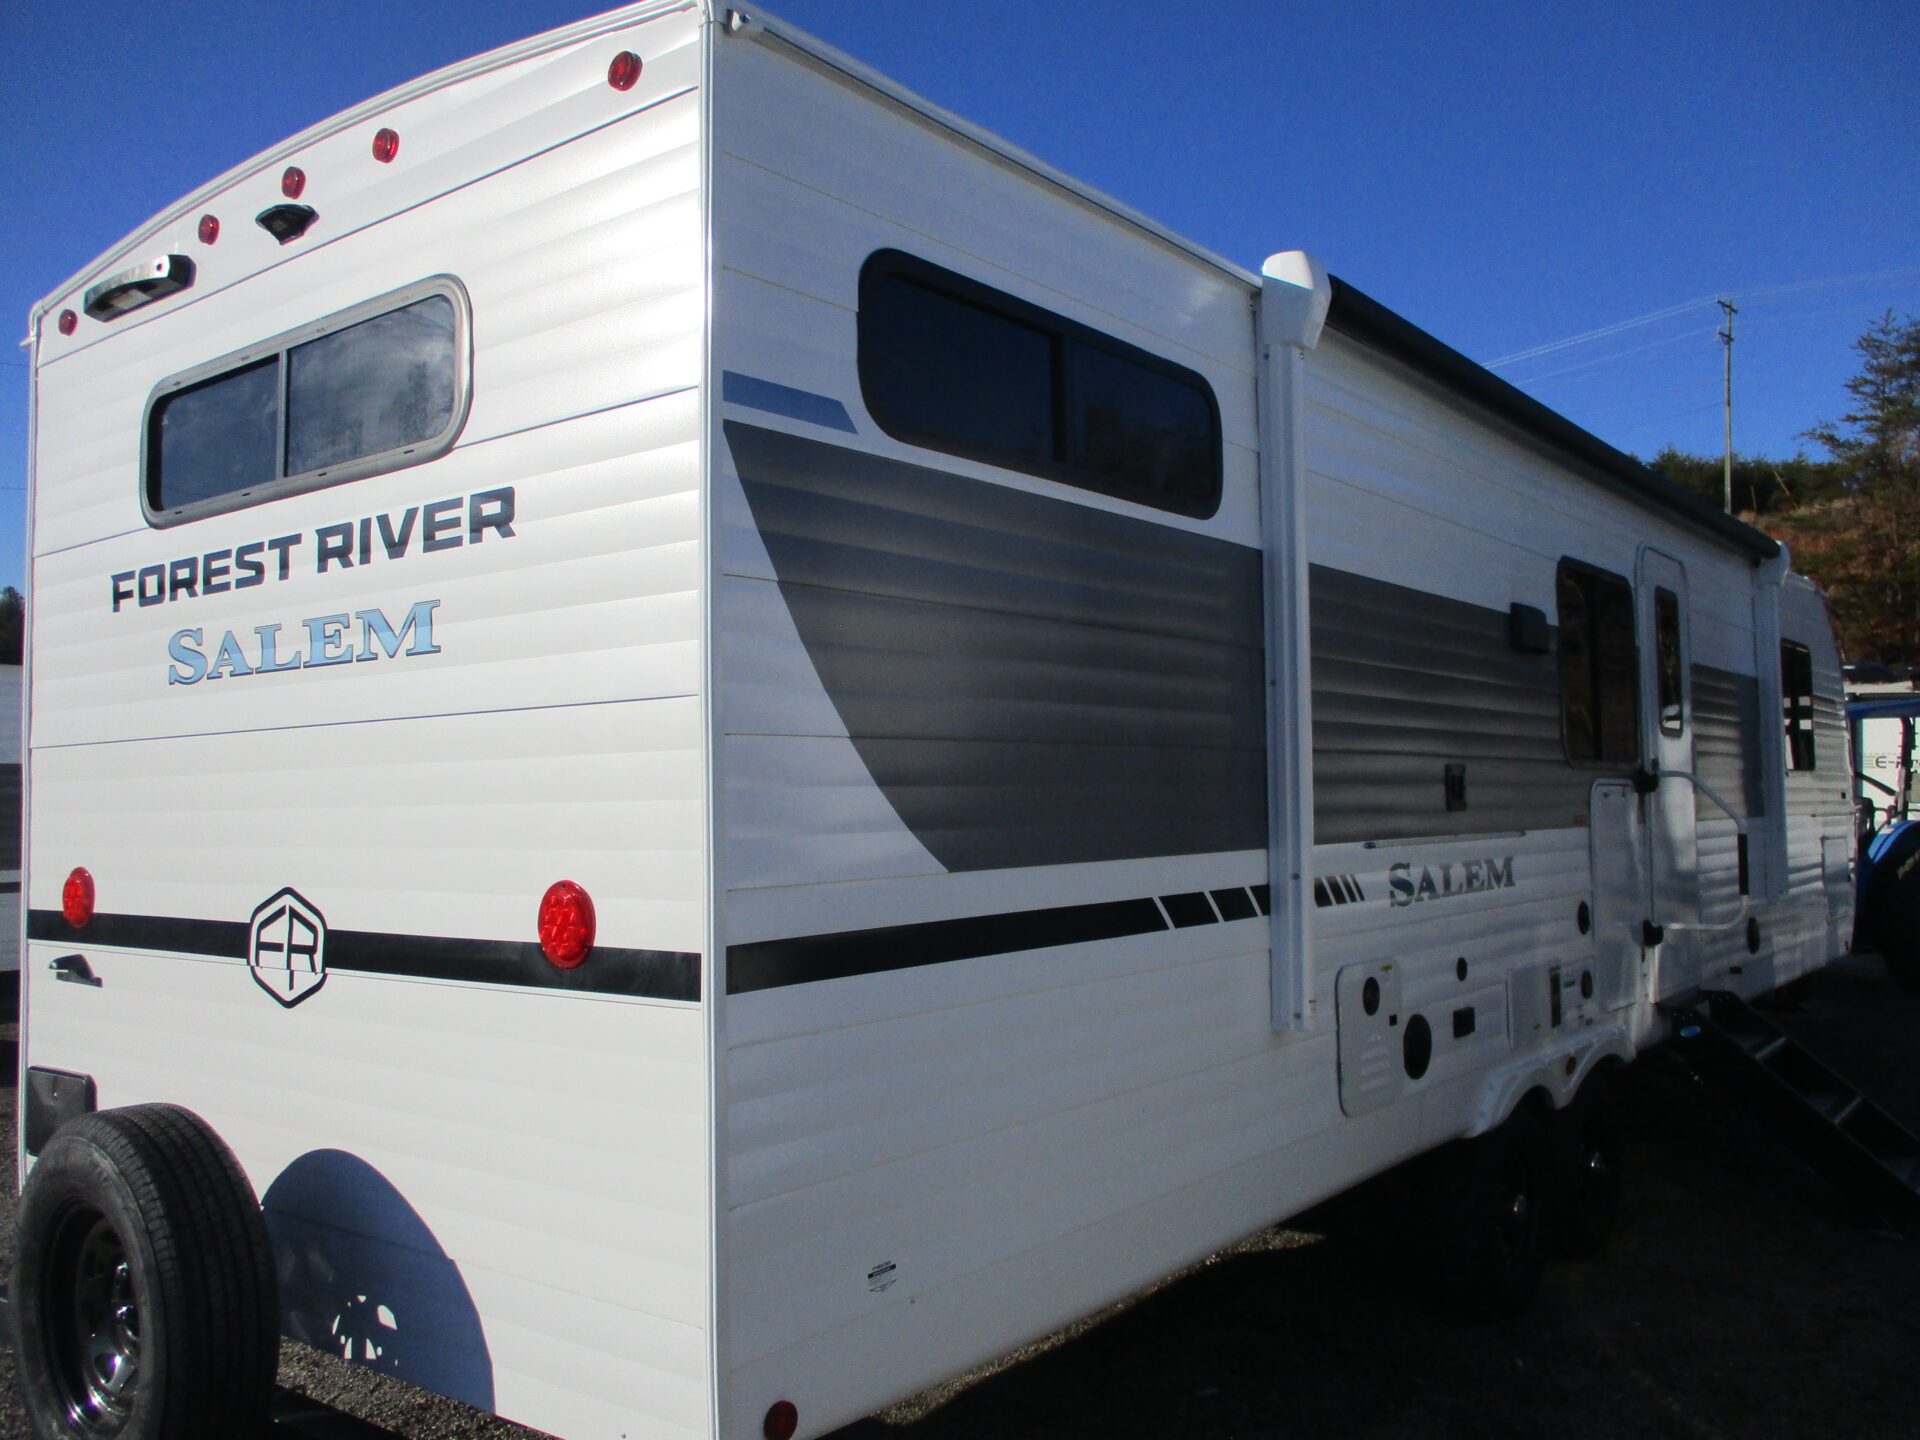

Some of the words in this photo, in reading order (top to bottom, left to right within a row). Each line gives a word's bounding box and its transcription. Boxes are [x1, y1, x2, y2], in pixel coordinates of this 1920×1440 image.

[111, 533, 302, 613] FOREST
[315, 486, 516, 574] RIVER
[168, 600, 441, 685] SALEM
[1389, 855, 1516, 908] SALEM
